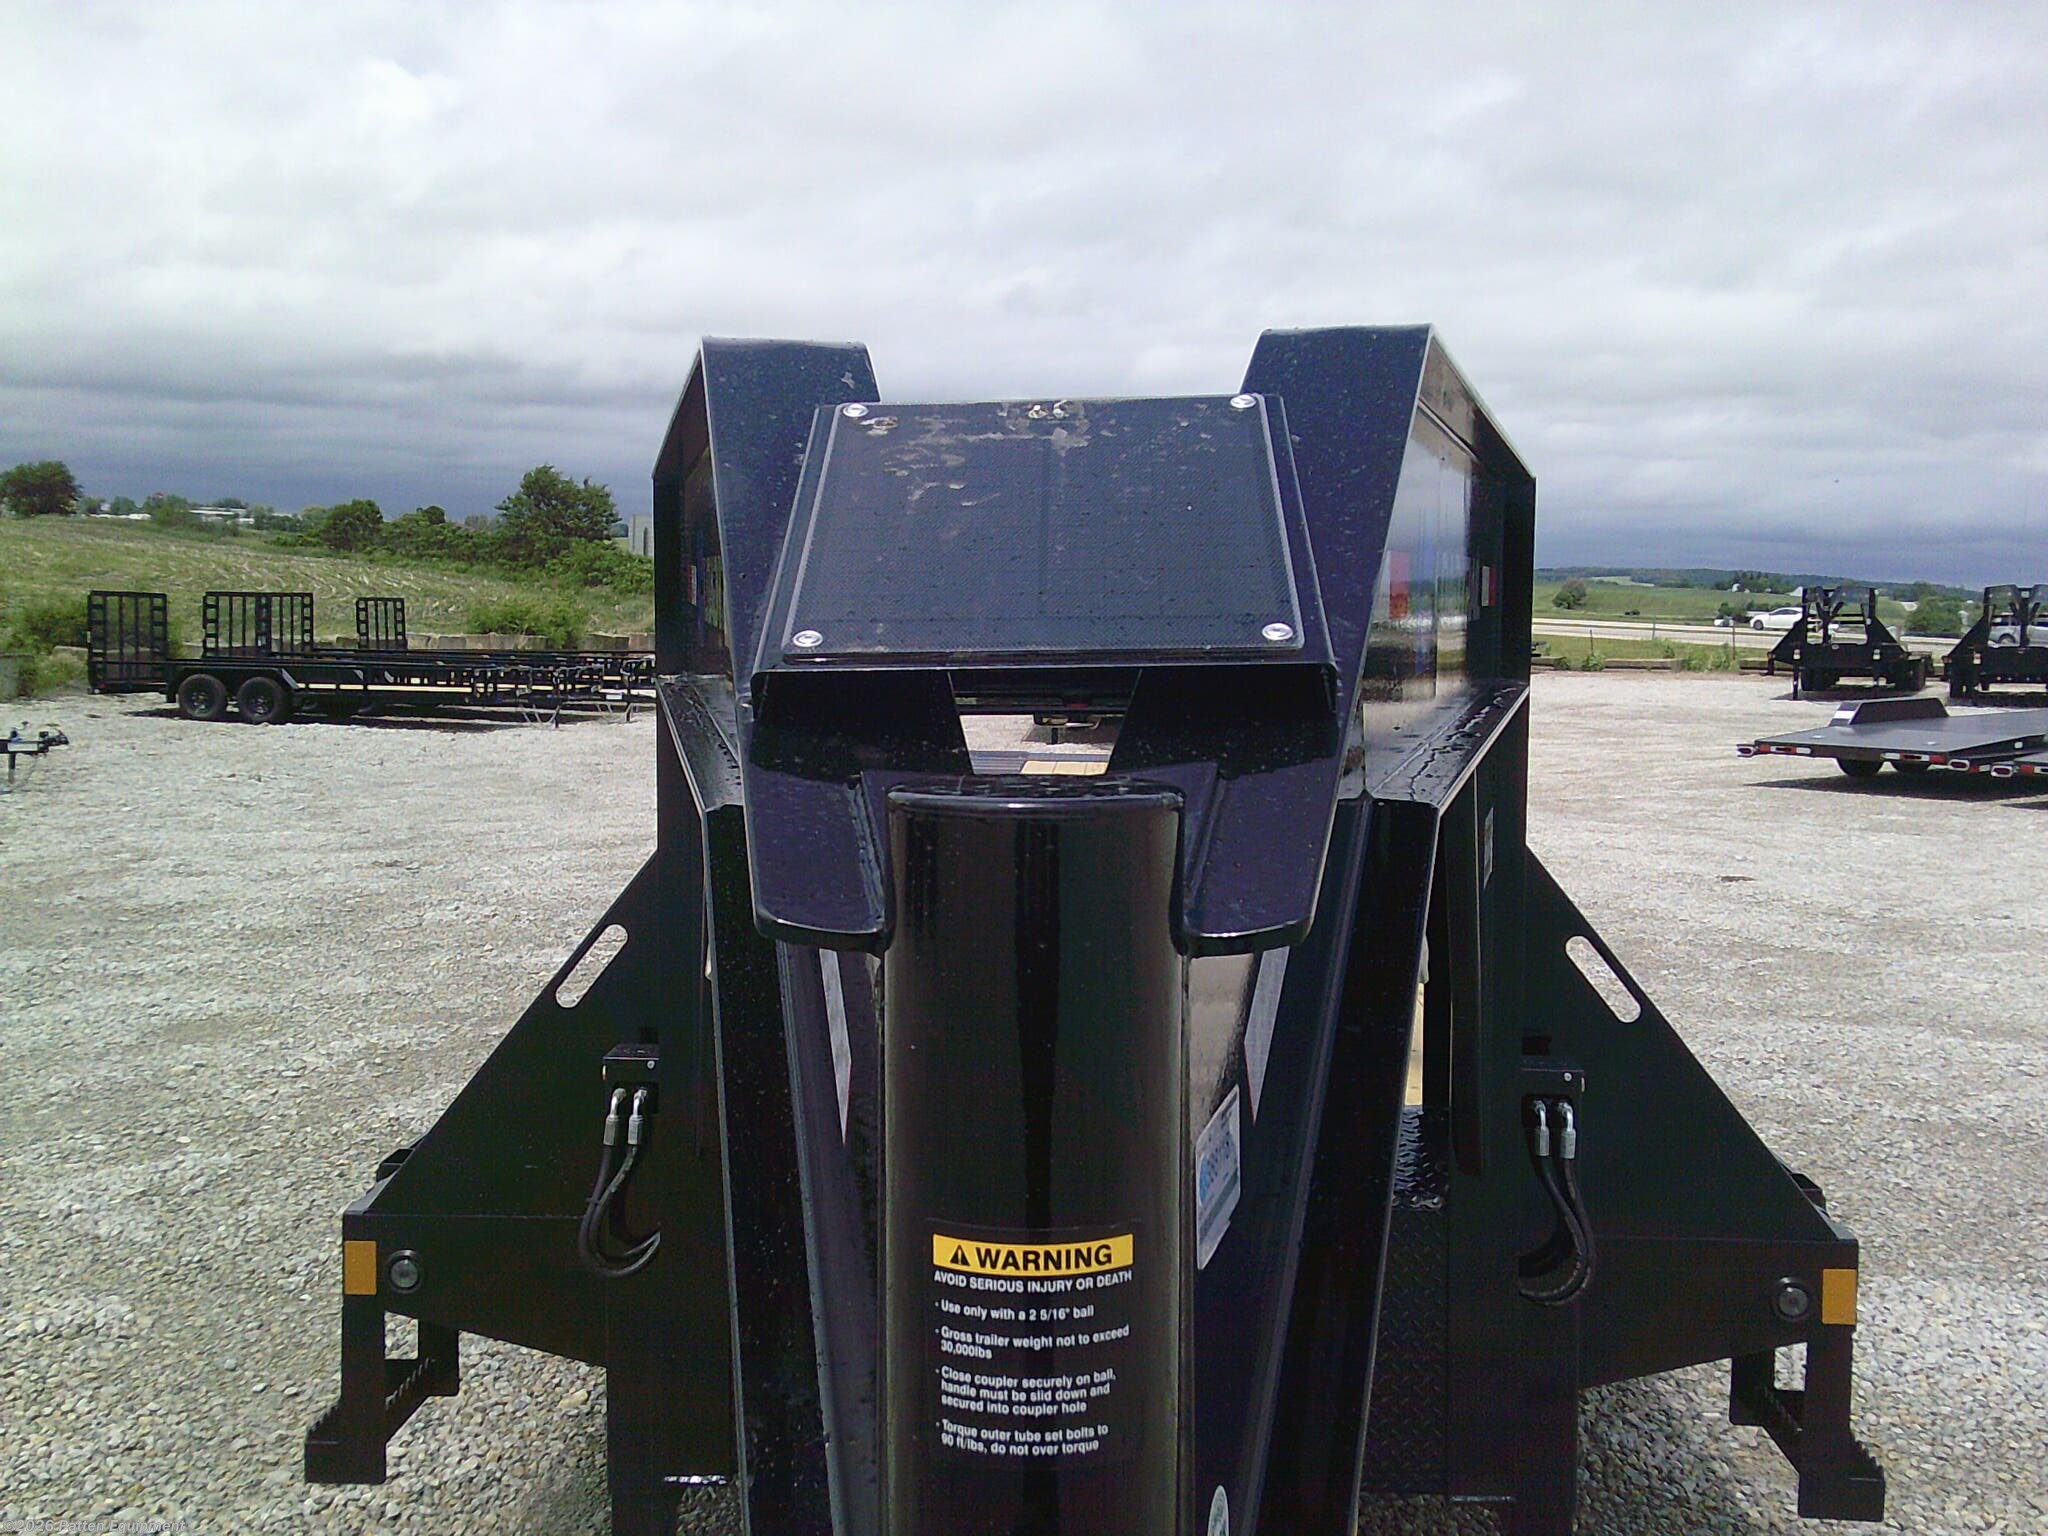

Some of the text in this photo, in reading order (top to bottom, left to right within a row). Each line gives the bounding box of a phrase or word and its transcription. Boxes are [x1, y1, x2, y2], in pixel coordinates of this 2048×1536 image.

[975, 1244, 1112, 1271] WARNING
[934, 1269, 1133, 1293] AVOID SERIOUS INJURY OR DEATH
[941, 1299, 961, 1314] Use
[963, 1306, 988, 1321] only
[990, 1308, 1015, 1320] with
[1018, 1310, 1026, 1321] a
[1028, 1308, 1037, 1321] 2
[1073, 1304, 1095, 1319] ball
[941, 1323, 1130, 1351] Gross trailer weight not to exceed
[941, 1339, 993, 1359] 30,000lbs
[941, 1365, 1116, 1389] Close coupler securely on ball,
[941, 1379, 1110, 1402] handle must be slid down and
[941, 1394, 1087, 1418] secured into coupler hole
[941, 1418, 1109, 1442] Torque outer tube set bolts to
[941, 1432, 1099, 1456] 90 ft/lbs, do not over torque
